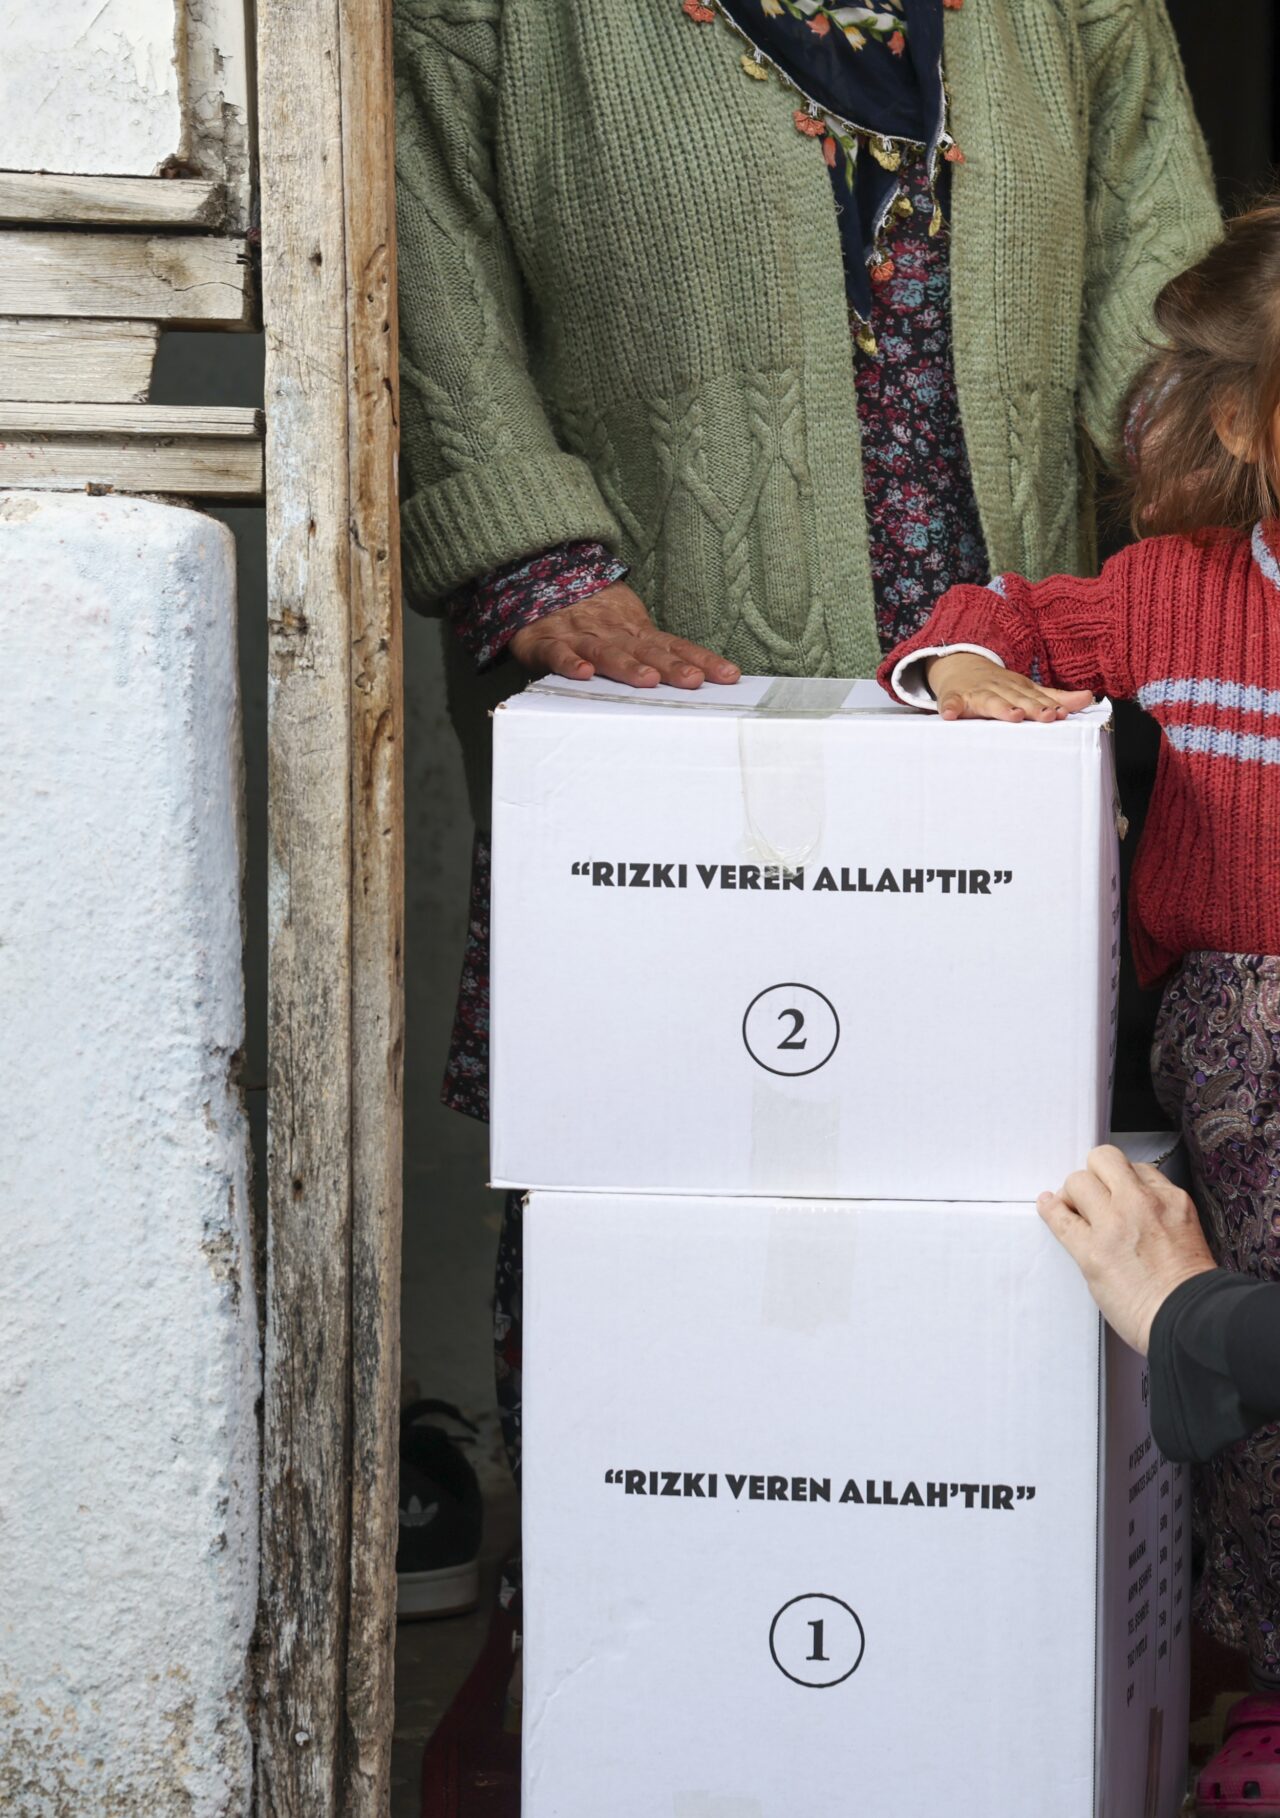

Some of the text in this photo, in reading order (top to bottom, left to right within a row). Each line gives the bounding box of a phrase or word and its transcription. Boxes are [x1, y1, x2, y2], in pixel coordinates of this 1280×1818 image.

[571, 861, 1013, 895] “RIZKI VEREN ALLAH’TIR”
[776, 1008, 808, 1050] 2
[604, 1468, 1036, 1511] “RIZKI VEREN ALLAH’TIR”
[805, 1619, 830, 1661] 1
